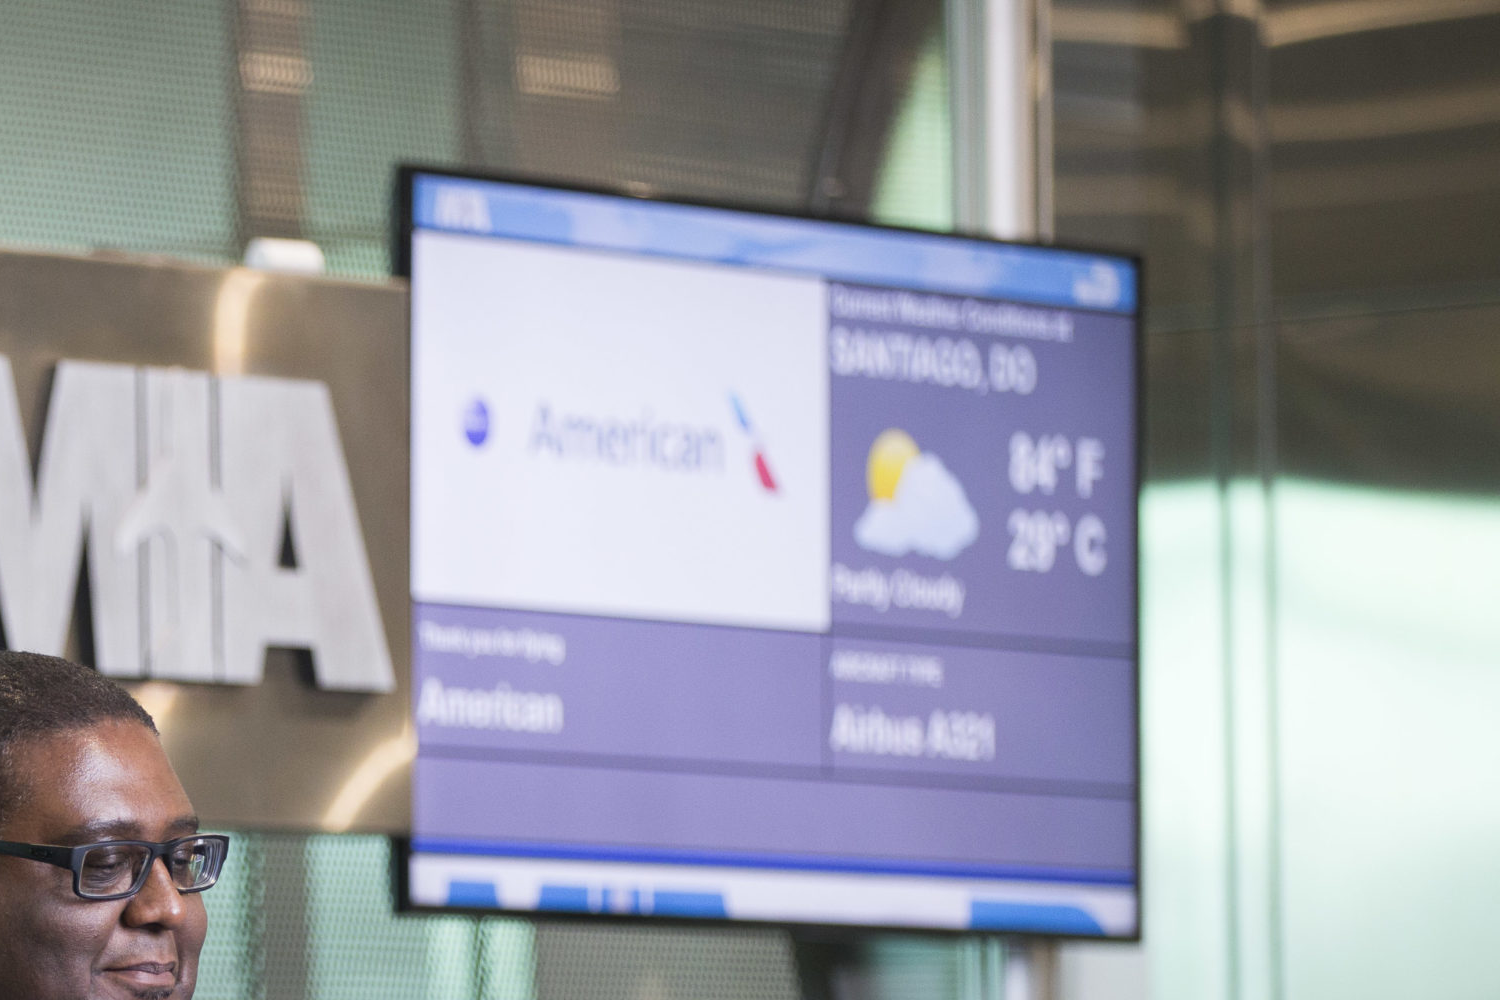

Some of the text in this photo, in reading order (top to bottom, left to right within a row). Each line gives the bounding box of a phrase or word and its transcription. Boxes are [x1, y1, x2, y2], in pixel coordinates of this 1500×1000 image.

[528, 401, 727, 471] American
[1074, 514, 1107, 576] C
[417, 676, 564, 734] American
[829, 703, 924, 757] Airbus
